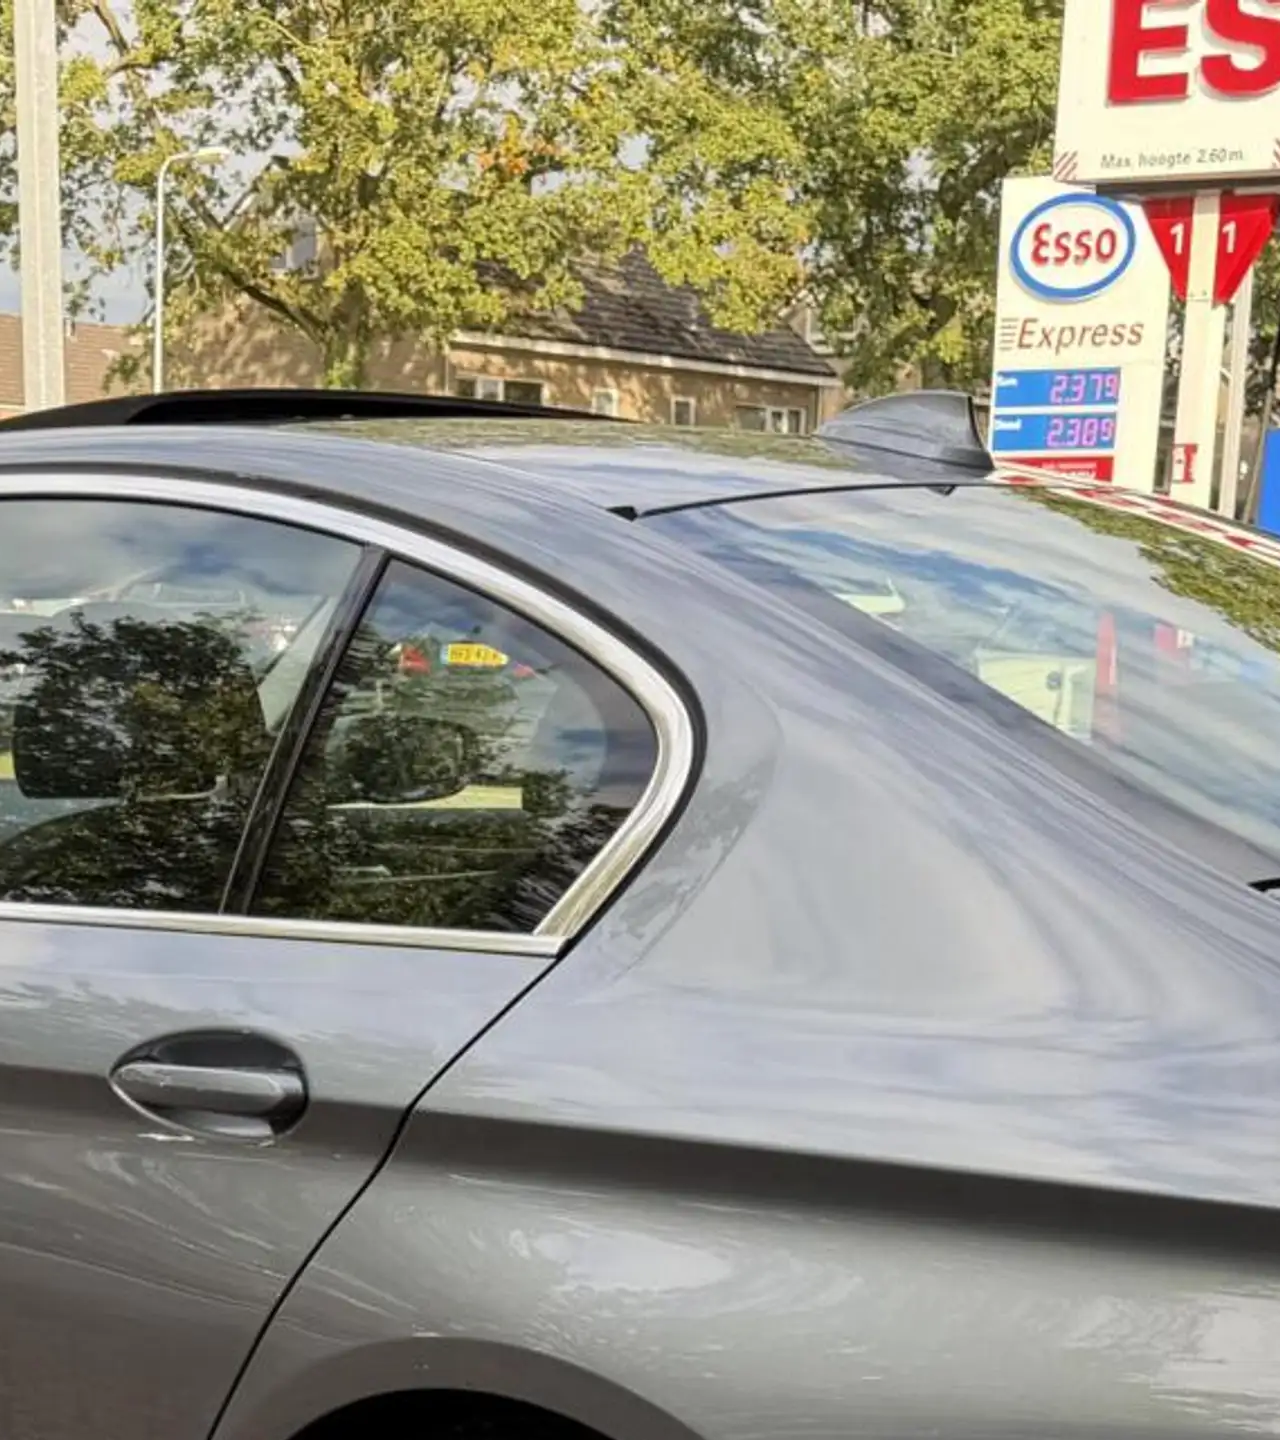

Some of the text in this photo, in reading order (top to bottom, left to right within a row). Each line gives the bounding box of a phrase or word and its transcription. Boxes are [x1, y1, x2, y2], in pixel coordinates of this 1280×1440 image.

[1138, 151, 1192, 168] hoogte
[1030, 222, 1117, 267] Esso
[1170, 222, 1185, 255] 1
[1222, 220, 1237, 253] 1
[1017, 317, 1145, 355] Express
